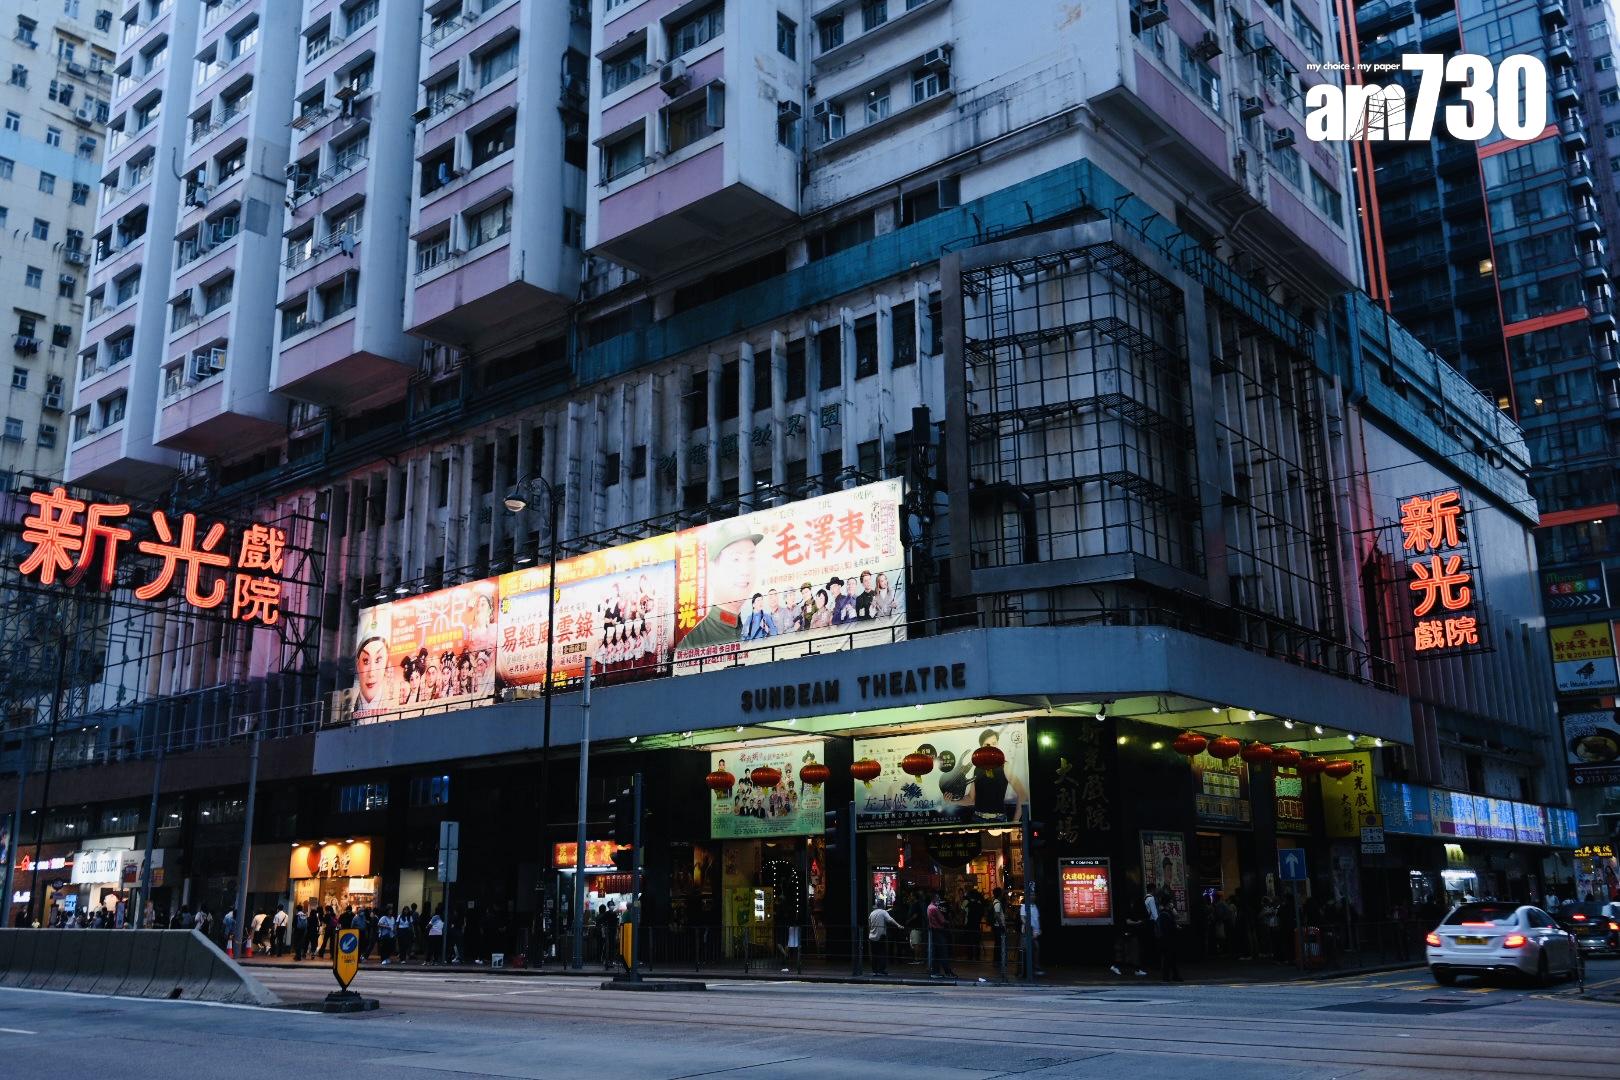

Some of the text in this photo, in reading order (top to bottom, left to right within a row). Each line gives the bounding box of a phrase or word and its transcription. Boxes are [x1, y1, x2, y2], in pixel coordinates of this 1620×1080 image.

[772, 508, 871, 566] 毛澤東
[502, 611, 595, 653] 易經風雲錄
[741, 662, 966, 712] SUNBEAM THEATRE
